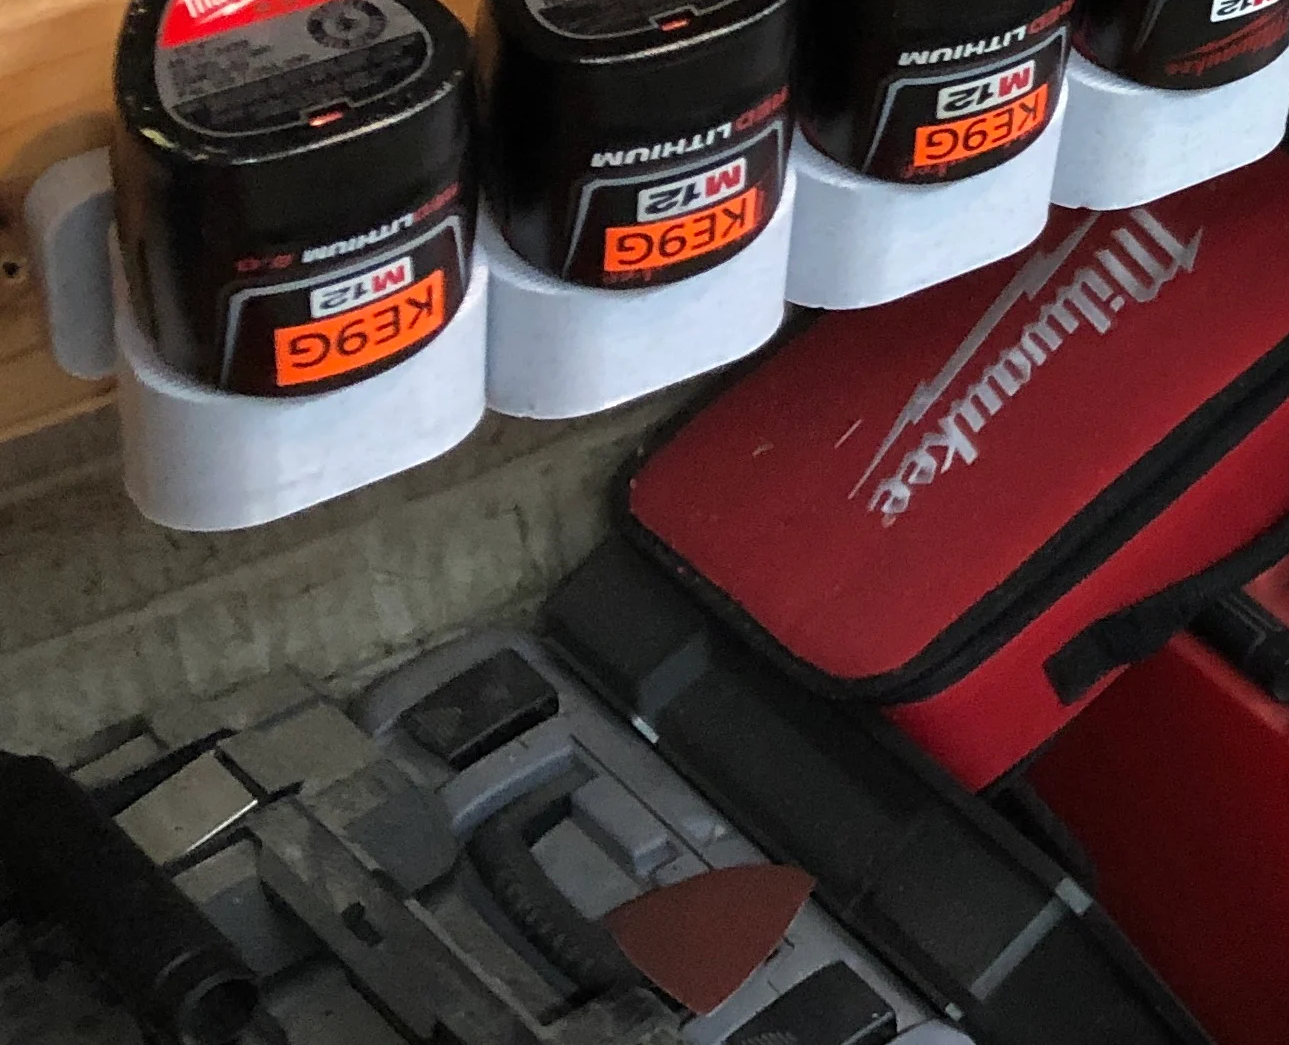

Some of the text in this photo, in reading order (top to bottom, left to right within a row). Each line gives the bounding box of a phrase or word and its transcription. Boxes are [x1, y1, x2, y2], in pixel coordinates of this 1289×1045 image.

[943, 66, 1031, 113] M12
[925, 92, 1040, 160] KE9G
[644, 164, 742, 216] M12
[616, 197, 747, 266] KE9G
[320, 264, 406, 310] M12
[288, 284, 434, 369] KE9G
[866, 208, 1204, 528] Milwaukee
